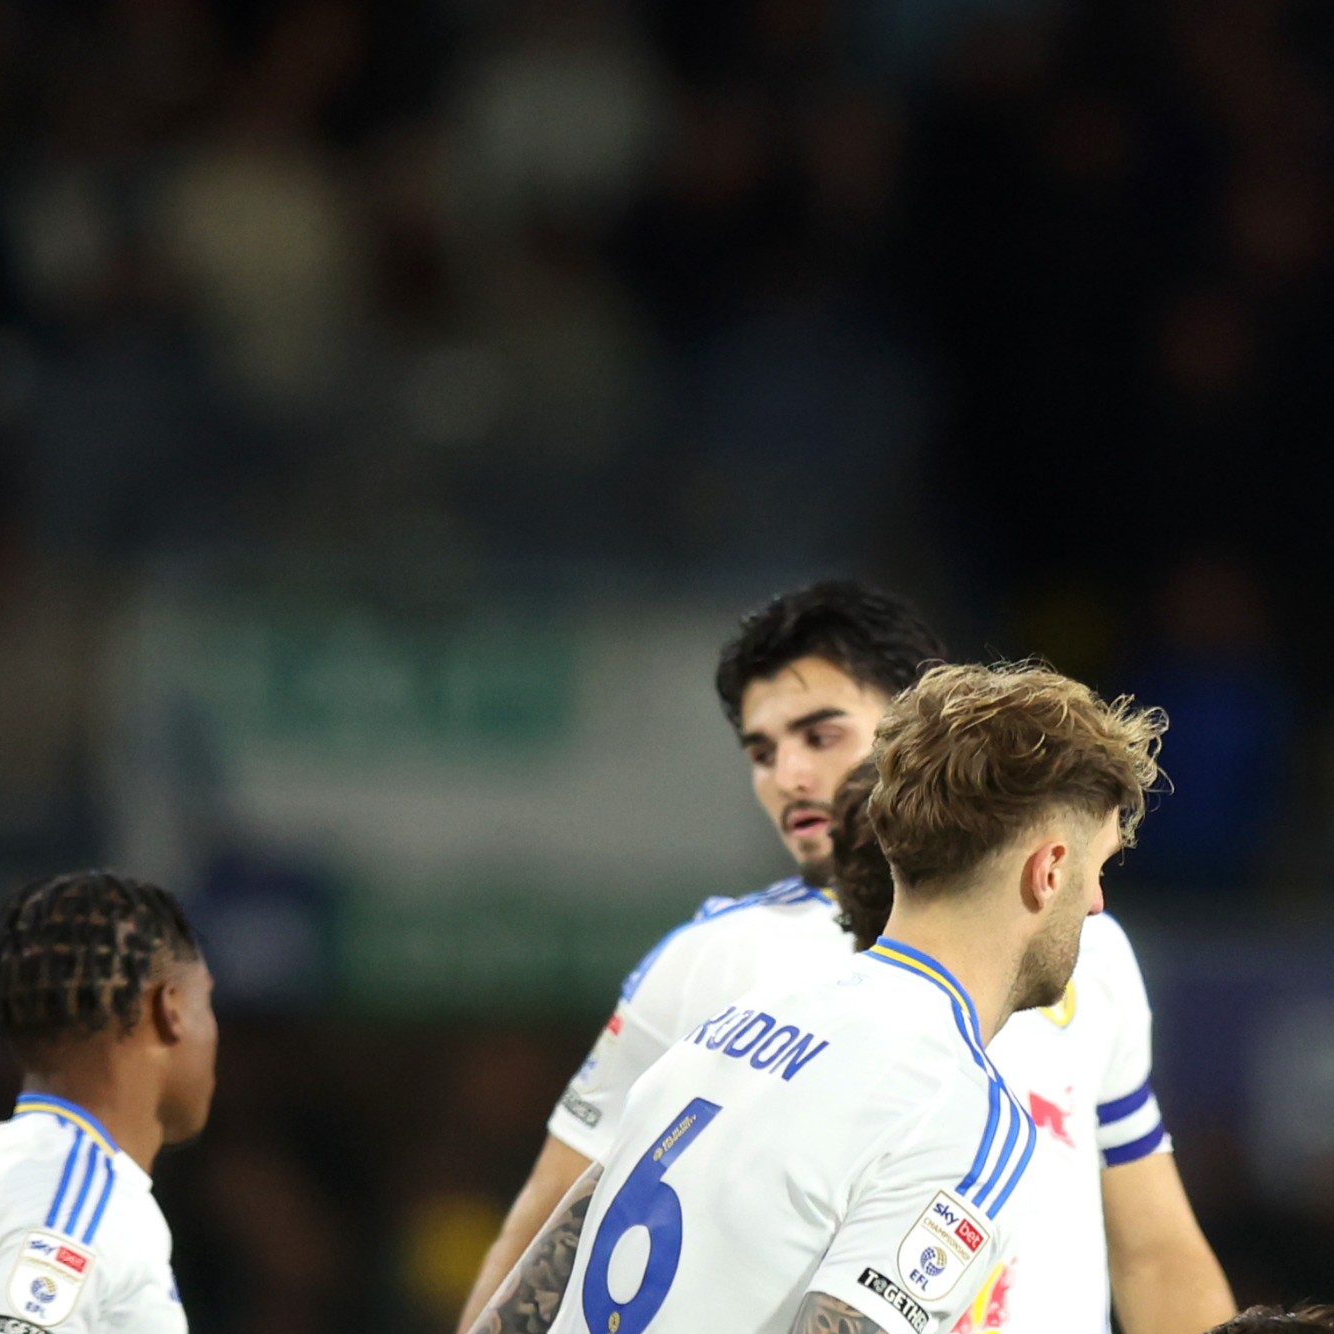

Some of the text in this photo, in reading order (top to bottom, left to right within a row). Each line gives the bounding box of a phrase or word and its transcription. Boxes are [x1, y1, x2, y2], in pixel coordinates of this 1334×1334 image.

[922, 1216, 971, 1262] CHAMPIONSHIP
[933, 1202, 982, 1249] sky bet
[908, 1268, 931, 1293] EFL
